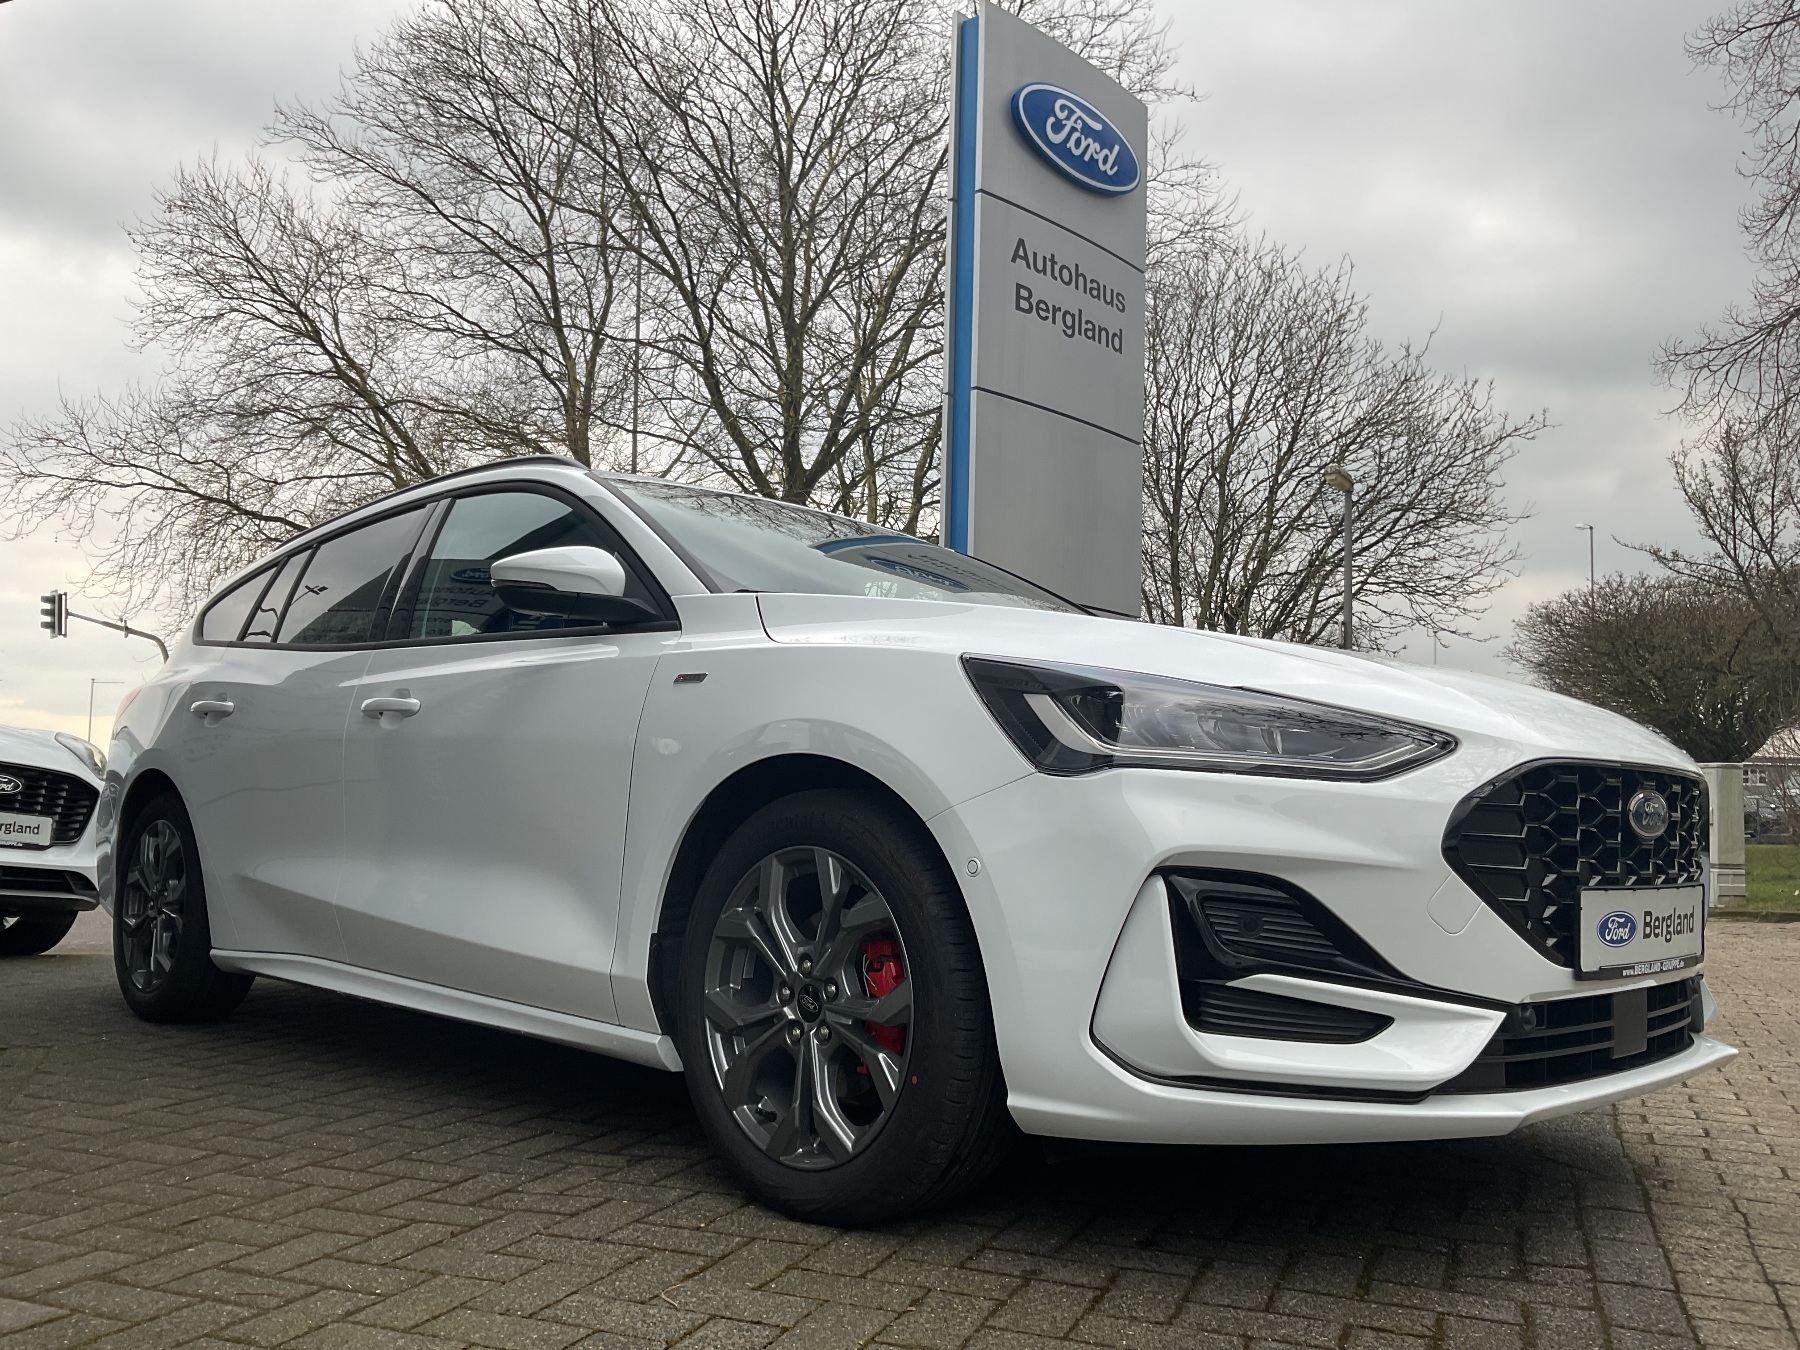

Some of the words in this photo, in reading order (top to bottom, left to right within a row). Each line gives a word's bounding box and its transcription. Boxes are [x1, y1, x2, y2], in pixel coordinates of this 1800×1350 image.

[1046, 99, 1119, 176] Ford
[1010, 237, 1126, 314] Autohaus
[1015, 282, 1123, 355] Bergland
[0, 777, 15, 791] ord
[0, 821, 40, 835] rgland
[1605, 917, 1631, 941] Ford
[1642, 905, 1695, 943] Bergland
